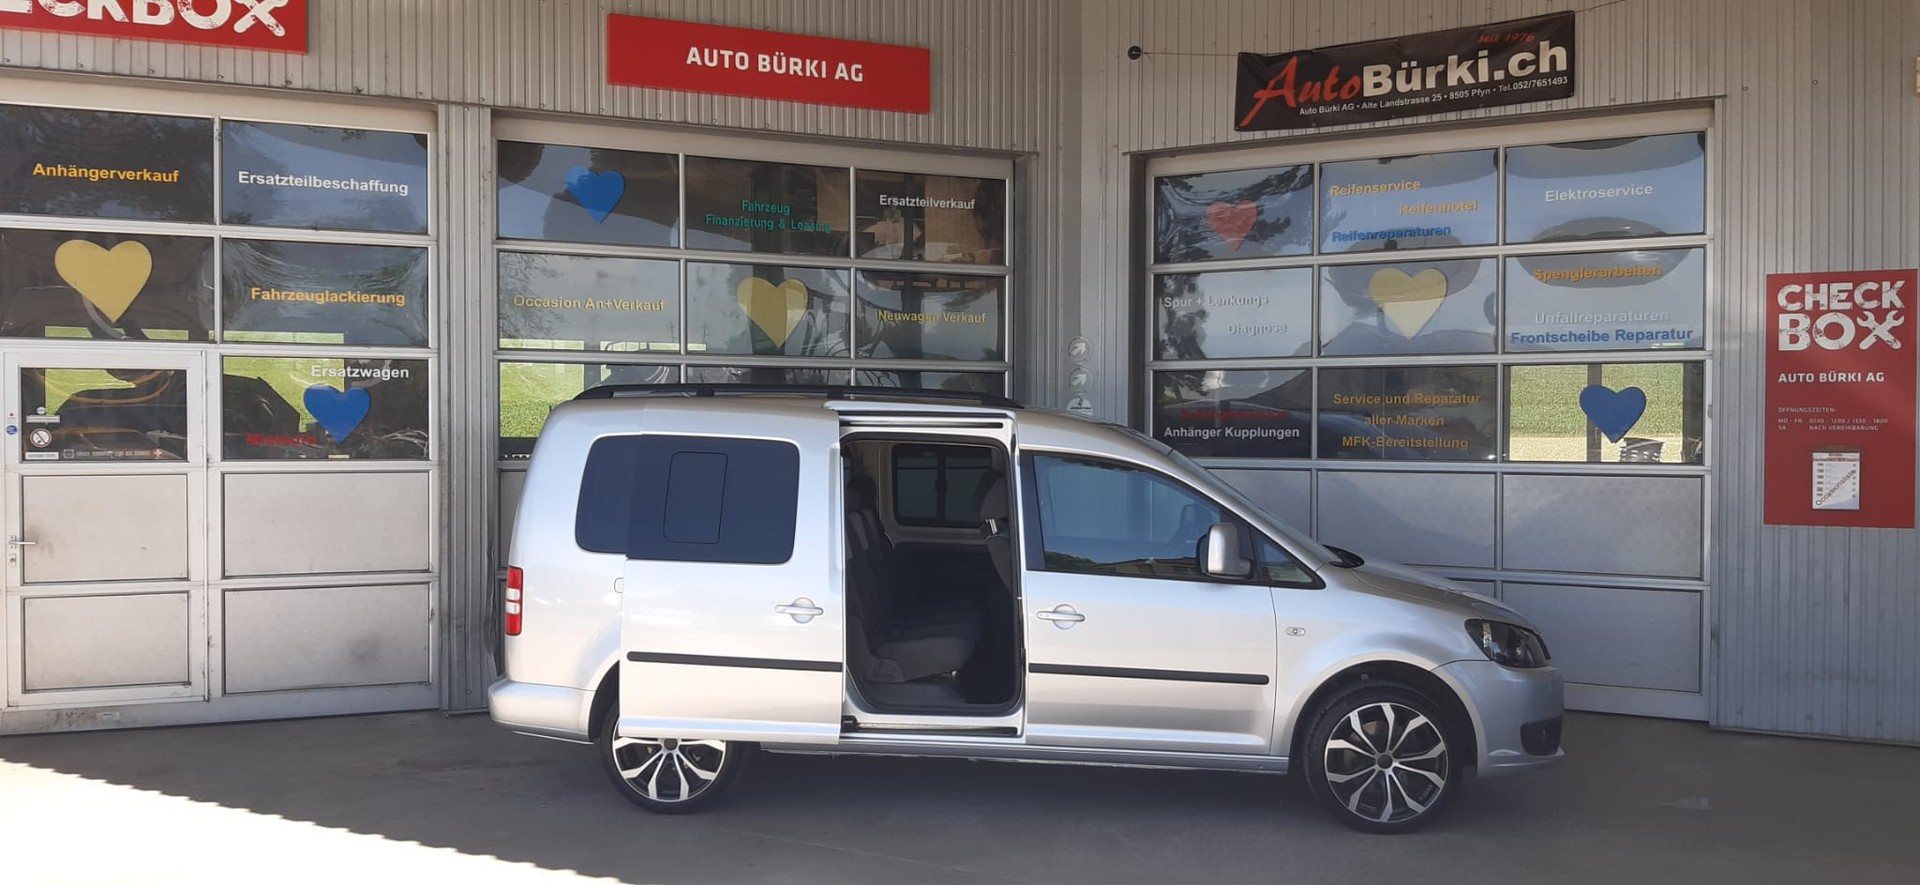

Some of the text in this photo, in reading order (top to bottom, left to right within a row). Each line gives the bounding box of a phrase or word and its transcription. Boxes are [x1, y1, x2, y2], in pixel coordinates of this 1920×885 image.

[686, 47, 865, 82] AUTO BÜRKI AG
[1299, 107, 1317, 115] Auto
[1319, 103, 1340, 112] Bürki
[1341, 103, 1355, 111] AG
[1361, 101, 1377, 109] Alte
[1379, 93, 1429, 108] Landstrasse
[1431, 94, 1442, 102] 25
[1449, 91, 1469, 99] 8505
[1471, 88, 1490, 98] Pfyn
[33, 163, 179, 183] Anhängerverkauf
[238, 171, 409, 197] Ersatzteilbeschaffung
[1329, 179, 1420, 196] Reifenservice
[879, 194, 976, 210] Ersatzteilverkauf
[1544, 184, 1653, 203] Elektroservice
[741, 199, 790, 216] Fahrzeug
[1398, 200, 1478, 216] Reifenhotel
[705, 213, 832, 233] Finanzierung & Leasing
[1331, 225, 1452, 243] Reifenreparaturen
[1532, 262, 1662, 284] Spenglerarbeiten
[250, 287, 406, 307] Fahrzeuglackierung
[513, 294, 666, 312] Occasion An+Verkauf
[1163, 296, 1192, 308] Spur
[1777, 280, 1905, 311] CHECK
[878, 309, 987, 325] Neuwagen Verkauf
[1534, 308, 1670, 325] Unfallreparaturen
[1228, 323, 1286, 336] Diagnose
[1511, 327, 1694, 345] Frontscheibe Reparatur
[1778, 310, 1905, 351] BOX
[311, 365, 409, 381] Ersatzwagen
[1778, 370, 1885, 383] AUTO BÜRKI AG
[1333, 393, 1480, 408] Service und Reparatur
[1365, 413, 1444, 427] aller Marken
[1163, 427, 1300, 440] Anhänger Kupplungen
[1342, 434, 1468, 450] MFK-Bereitstellung
